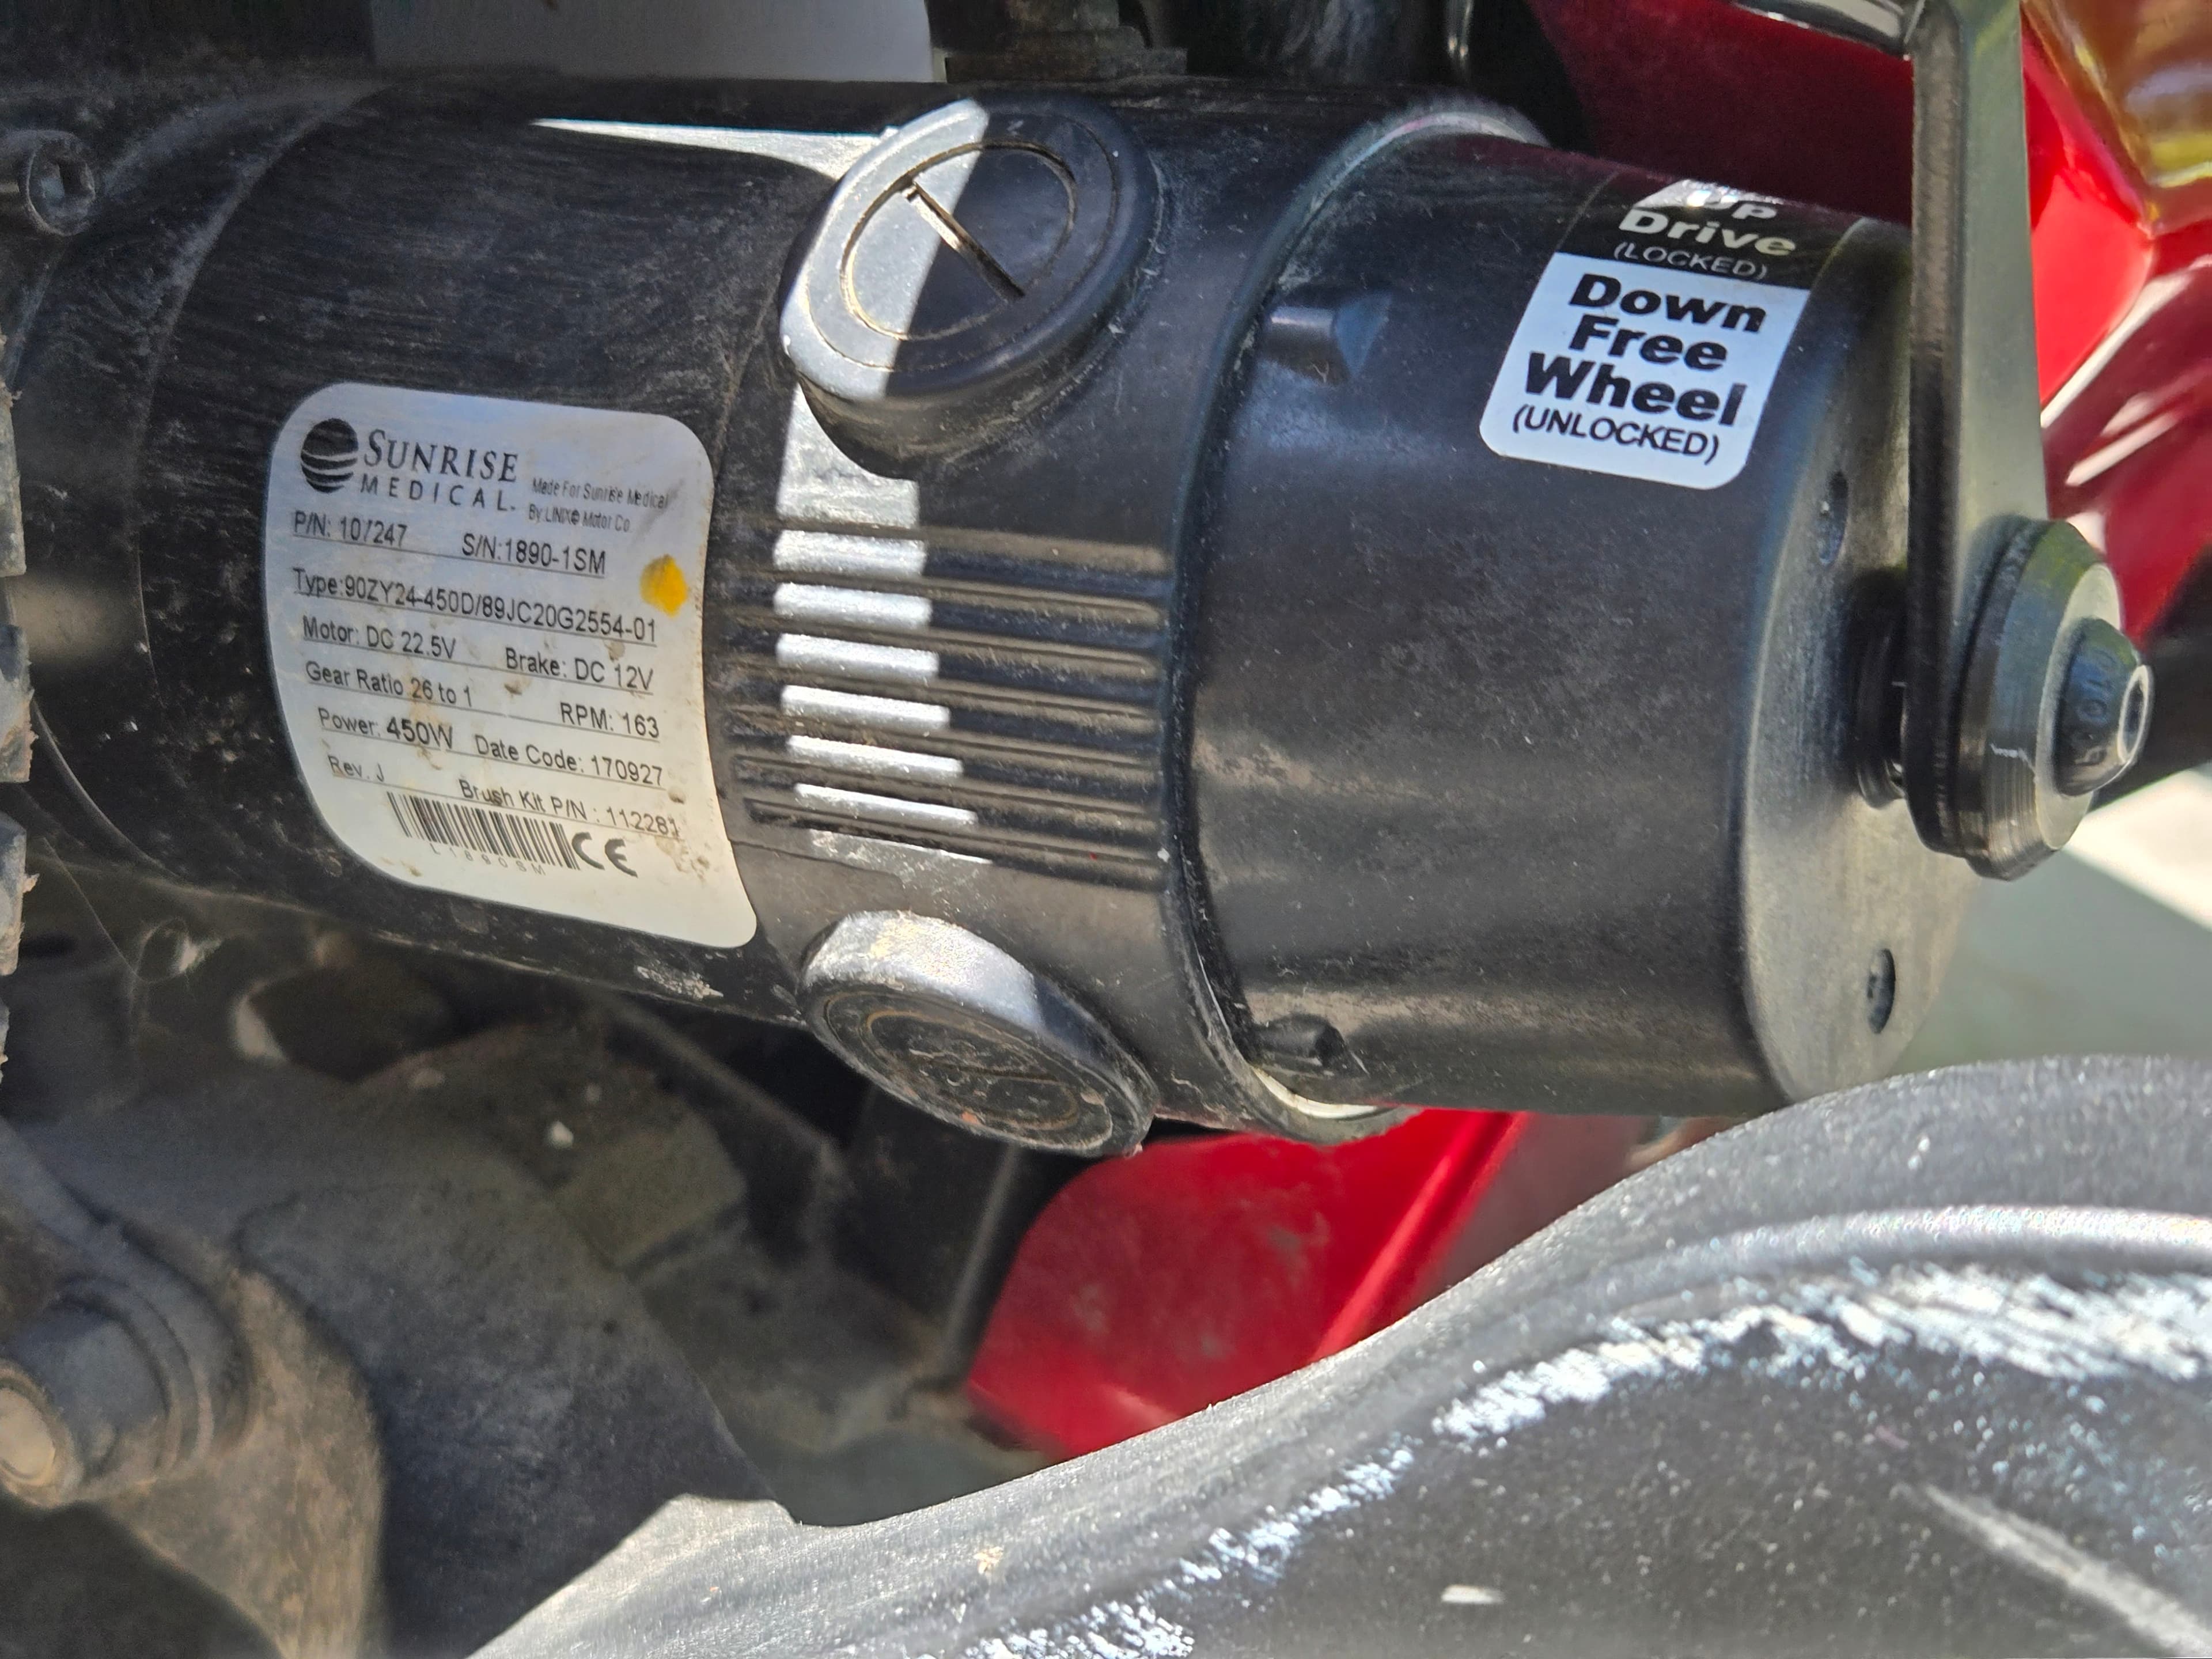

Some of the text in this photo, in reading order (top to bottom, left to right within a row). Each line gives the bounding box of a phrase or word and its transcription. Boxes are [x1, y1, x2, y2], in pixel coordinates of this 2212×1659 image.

[1618, 209, 1797, 256] Drive
[1613, 241, 1768, 281] (LOCKED)
[1568, 272, 1768, 334] Down
[1569, 313, 1728, 372] Free
[1524, 350, 1749, 427] Wheel
[363, 429, 518, 483] SUNRISE
[1512, 403, 1721, 465] (UNLOCKED)
[532, 476, 669, 510] Made For Sunrise Medical
[294, 510, 331, 538] P/N:
[528, 503, 543, 525] By
[581, 512, 612, 531] Motor
[302, 614, 457, 660] Motor: DC 22.5V
[305, 660, 472, 708] Gear Ratio 26 to 1
[505, 646, 654, 691] Brake: DC 12V
[317, 706, 454, 749] Power: 450W
[559, 701, 660, 739] RPM: 163
[327, 754, 385, 783] Rev. J
[474, 733, 663, 786] Date Code: 170927
[458, 778, 515, 808] Brush
[518, 789, 546, 814] Kit
[606, 806, 681, 837] 112281
